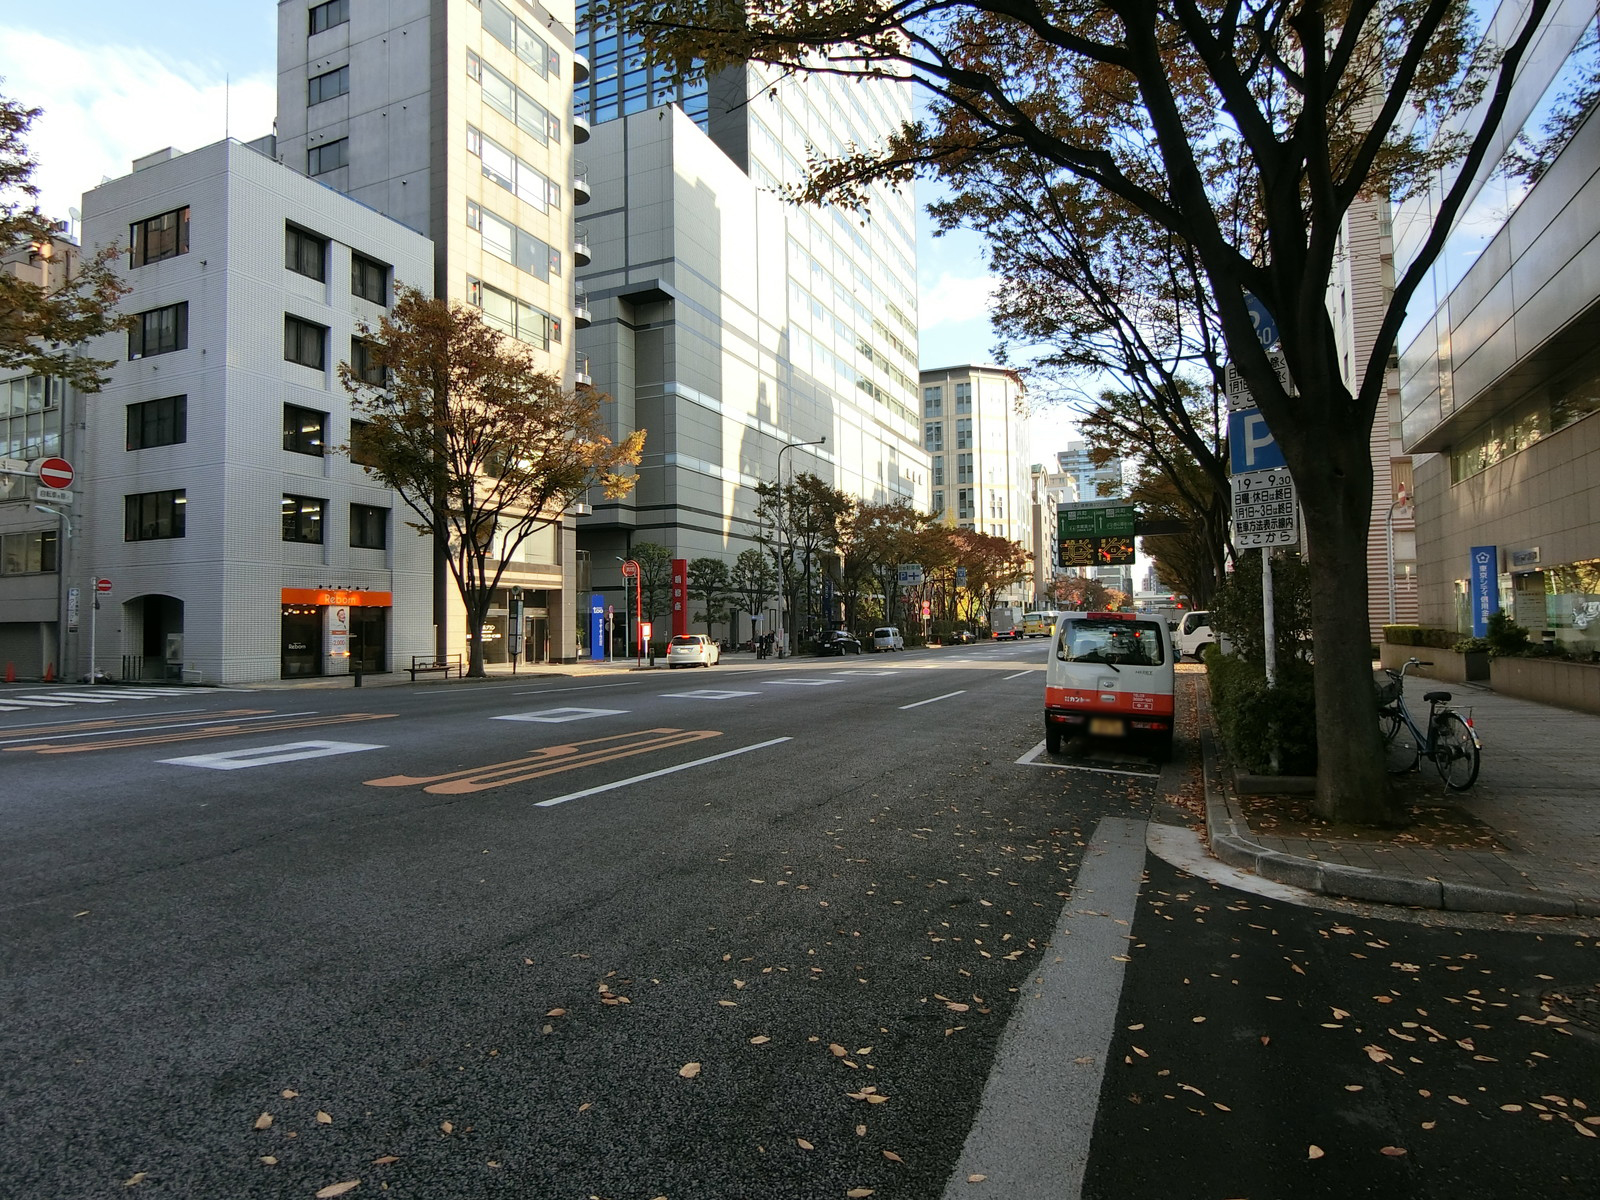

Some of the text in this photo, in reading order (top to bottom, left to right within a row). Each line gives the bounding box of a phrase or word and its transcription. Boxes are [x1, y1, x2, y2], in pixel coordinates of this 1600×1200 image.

[1240, 532, 1291, 545] ここから
[324, 594, 356, 604] Reborn
[1479, 565, 1489, 624] 東京シティ信用金庫
[362, 728, 724, 794] 50
